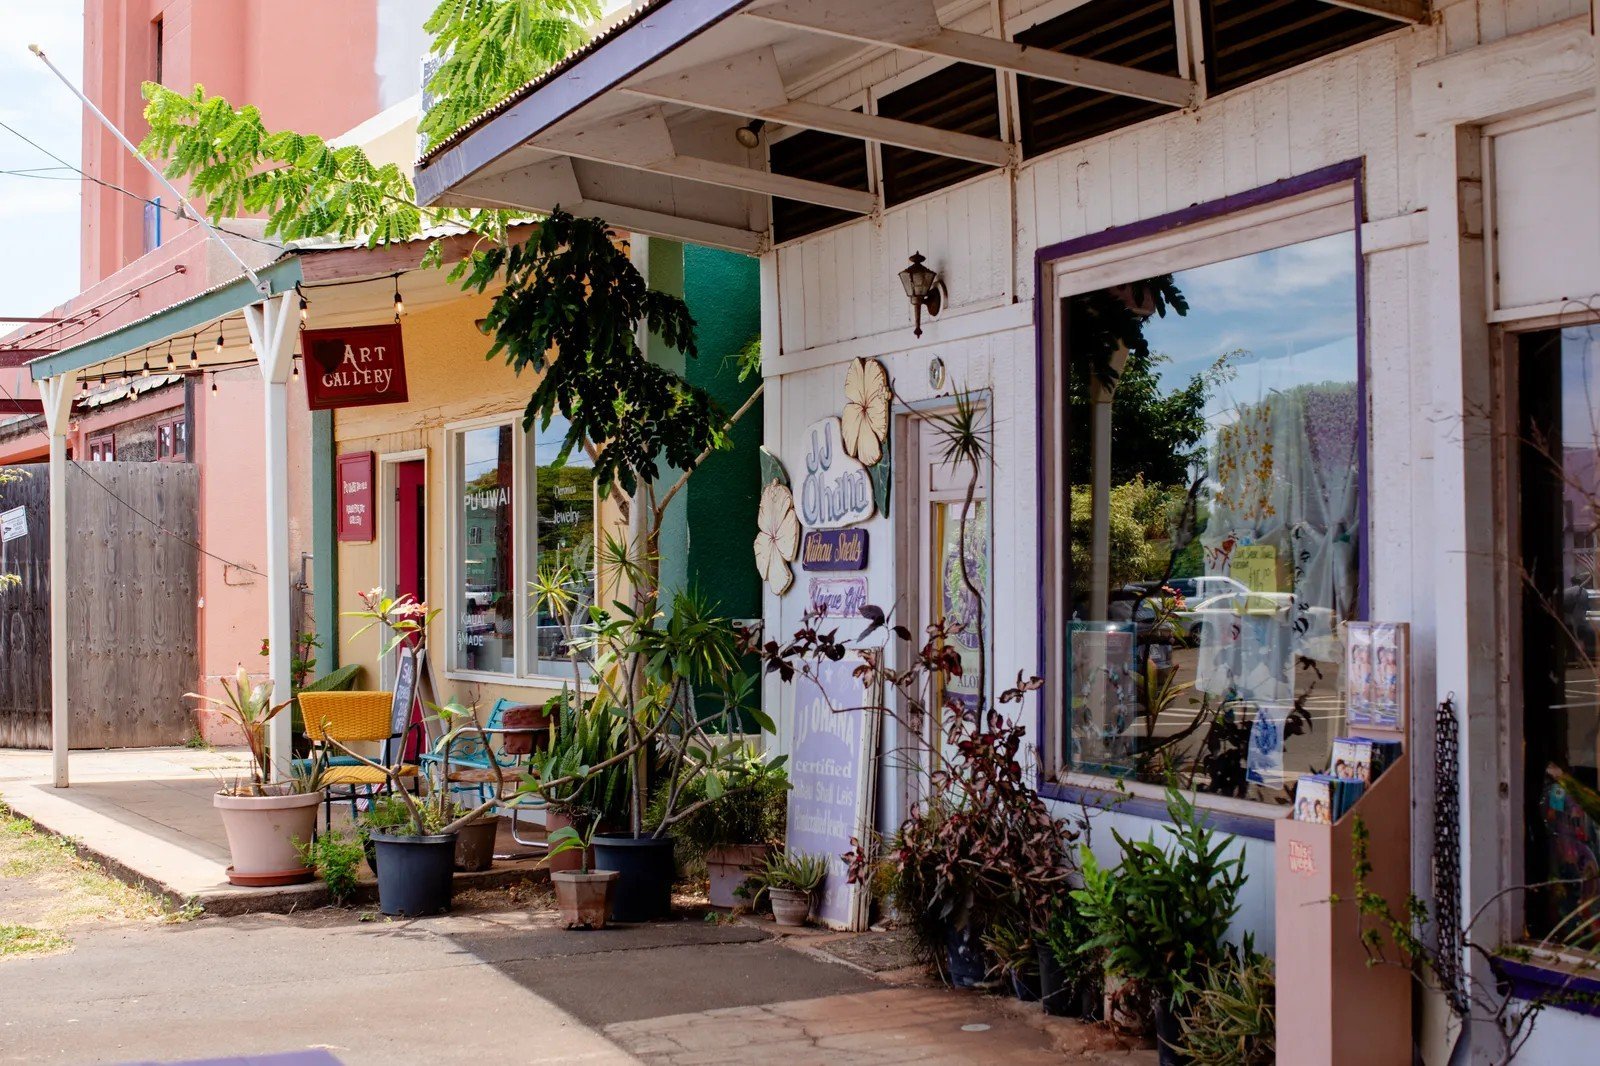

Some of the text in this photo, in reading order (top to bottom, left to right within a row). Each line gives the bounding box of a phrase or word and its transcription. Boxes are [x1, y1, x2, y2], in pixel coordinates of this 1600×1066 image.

[343, 344, 386, 372] ART
[322, 368, 393, 393] GALLERY
[806, 422, 832, 474] JJ
[802, 471, 869, 525] Ohana
[462, 633, 484, 647] MADE
[795, 758, 852, 779] certified
